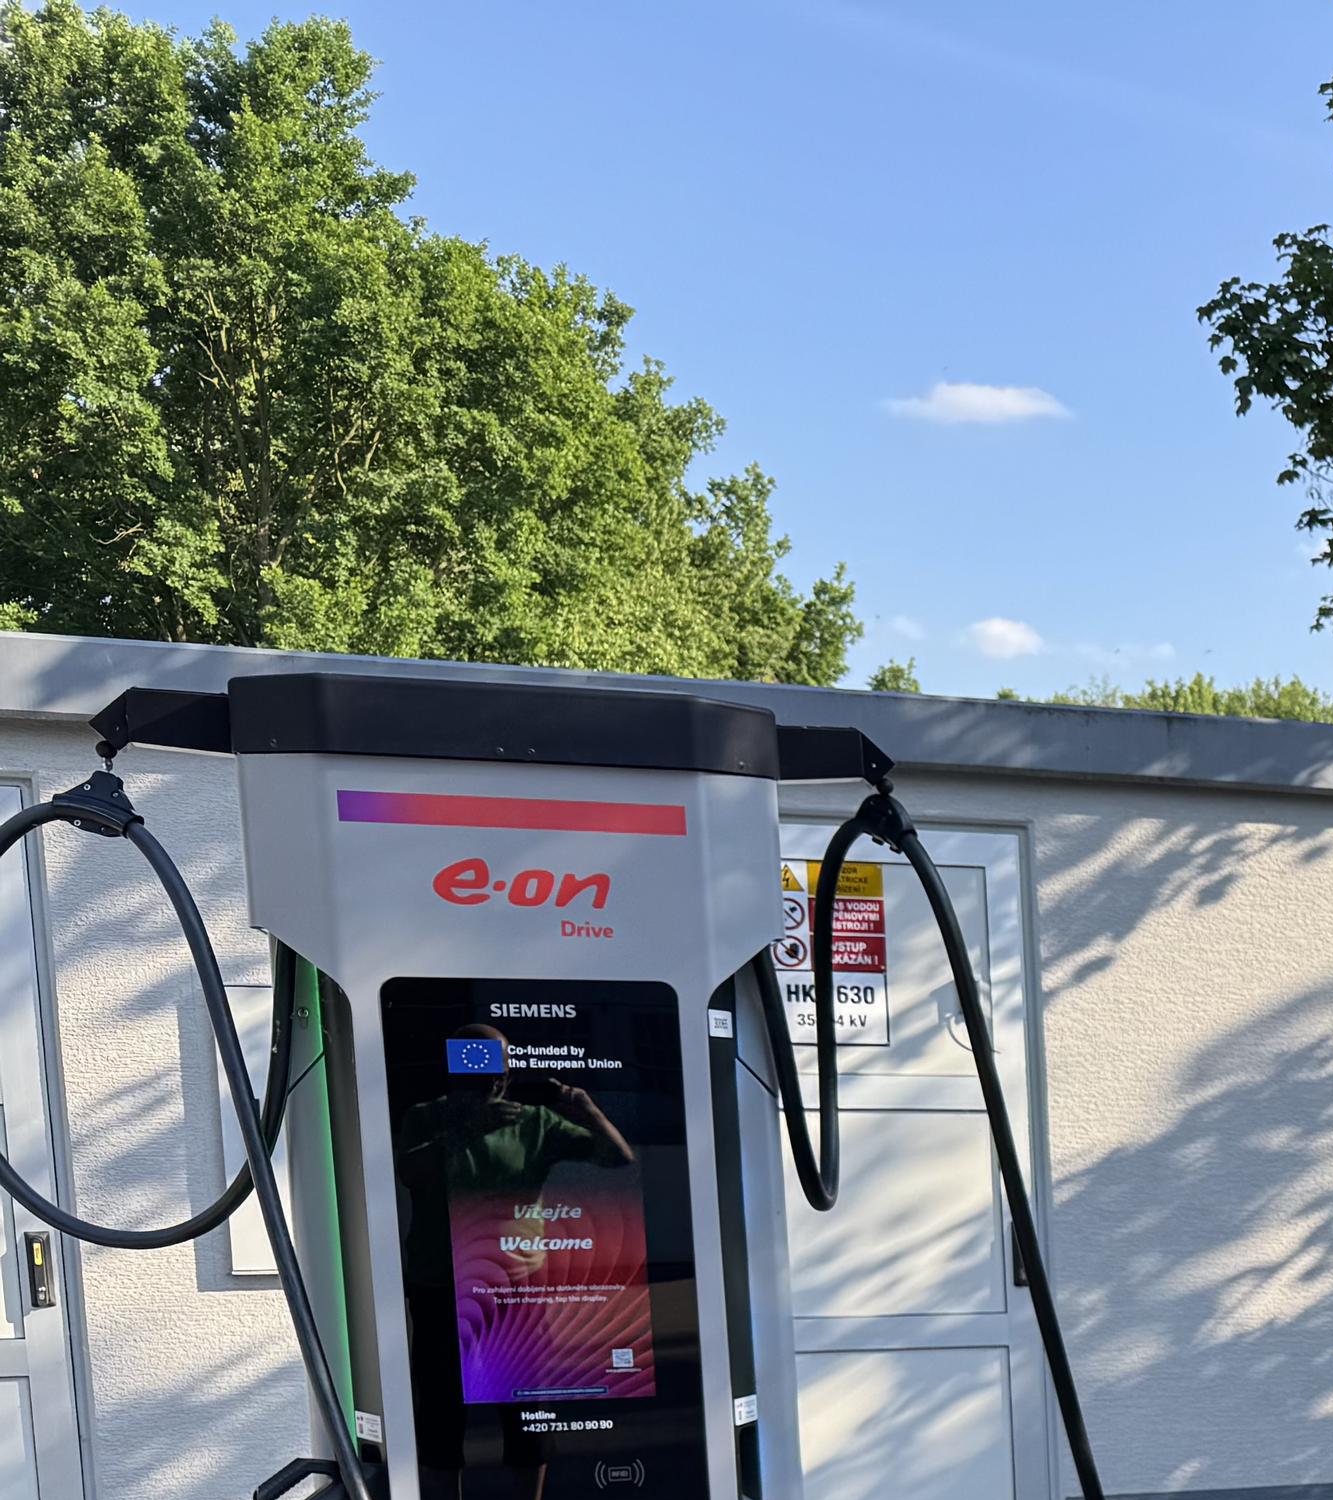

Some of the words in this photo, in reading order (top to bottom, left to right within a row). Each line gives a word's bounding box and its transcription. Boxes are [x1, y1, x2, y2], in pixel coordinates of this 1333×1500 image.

[847, 902, 880, 911] VODOU
[560, 920, 615, 939] Drive
[832, 942, 867, 952] VSTUP
[490, 1003, 577, 1018] SIEMENS
[849, 1014, 867, 1028] kV
[507, 1045, 568, 1056] Co-funded
[570, 1045, 585, 1058] by
[508, 1058, 527, 1068] the
[530, 1058, 585, 1071] European
[588, 1058, 623, 1069] Union
[513, 1203, 582, 1222] Vítejte
[499, 1236, 593, 1251] Welcome
[521, 1411, 557, 1421] Hotline
[522, 1422, 548, 1432] +420
[550, 1422, 569, 1431] 731
[585, 1420, 599, 1430] 90
